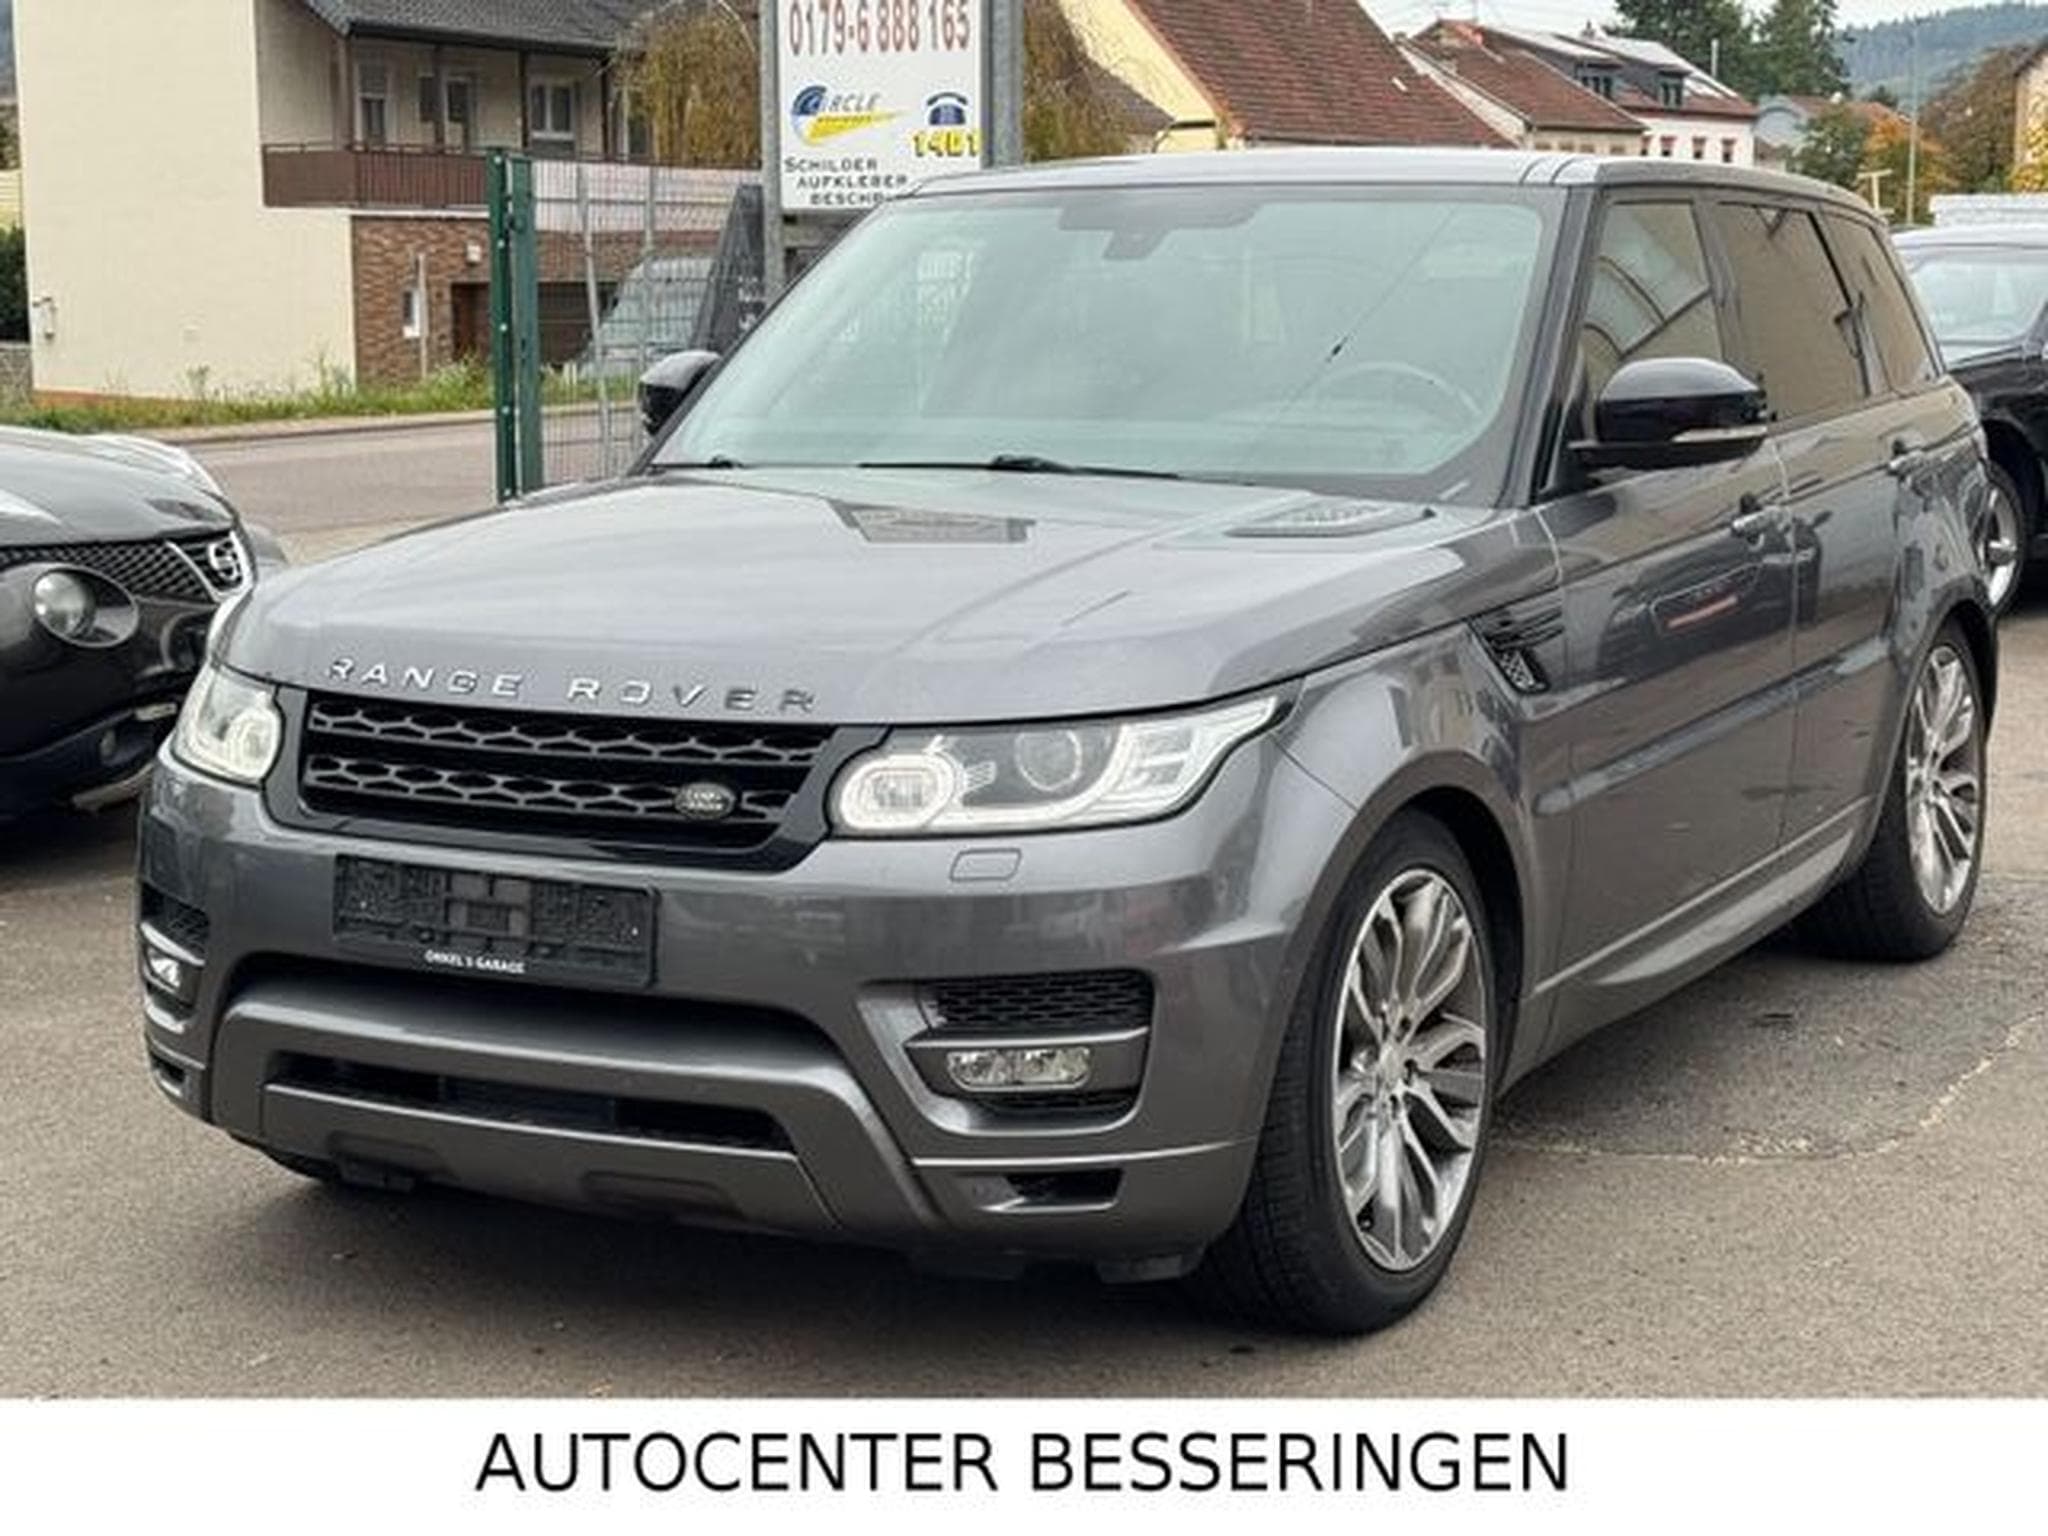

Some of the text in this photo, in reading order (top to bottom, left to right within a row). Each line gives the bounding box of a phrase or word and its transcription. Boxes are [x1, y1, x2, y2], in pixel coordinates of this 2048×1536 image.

[784, 156, 877, 173] SCHILDER
[797, 174, 907, 189] AUFKLEBER
[325, 657, 815, 713] RANGE ROVER
